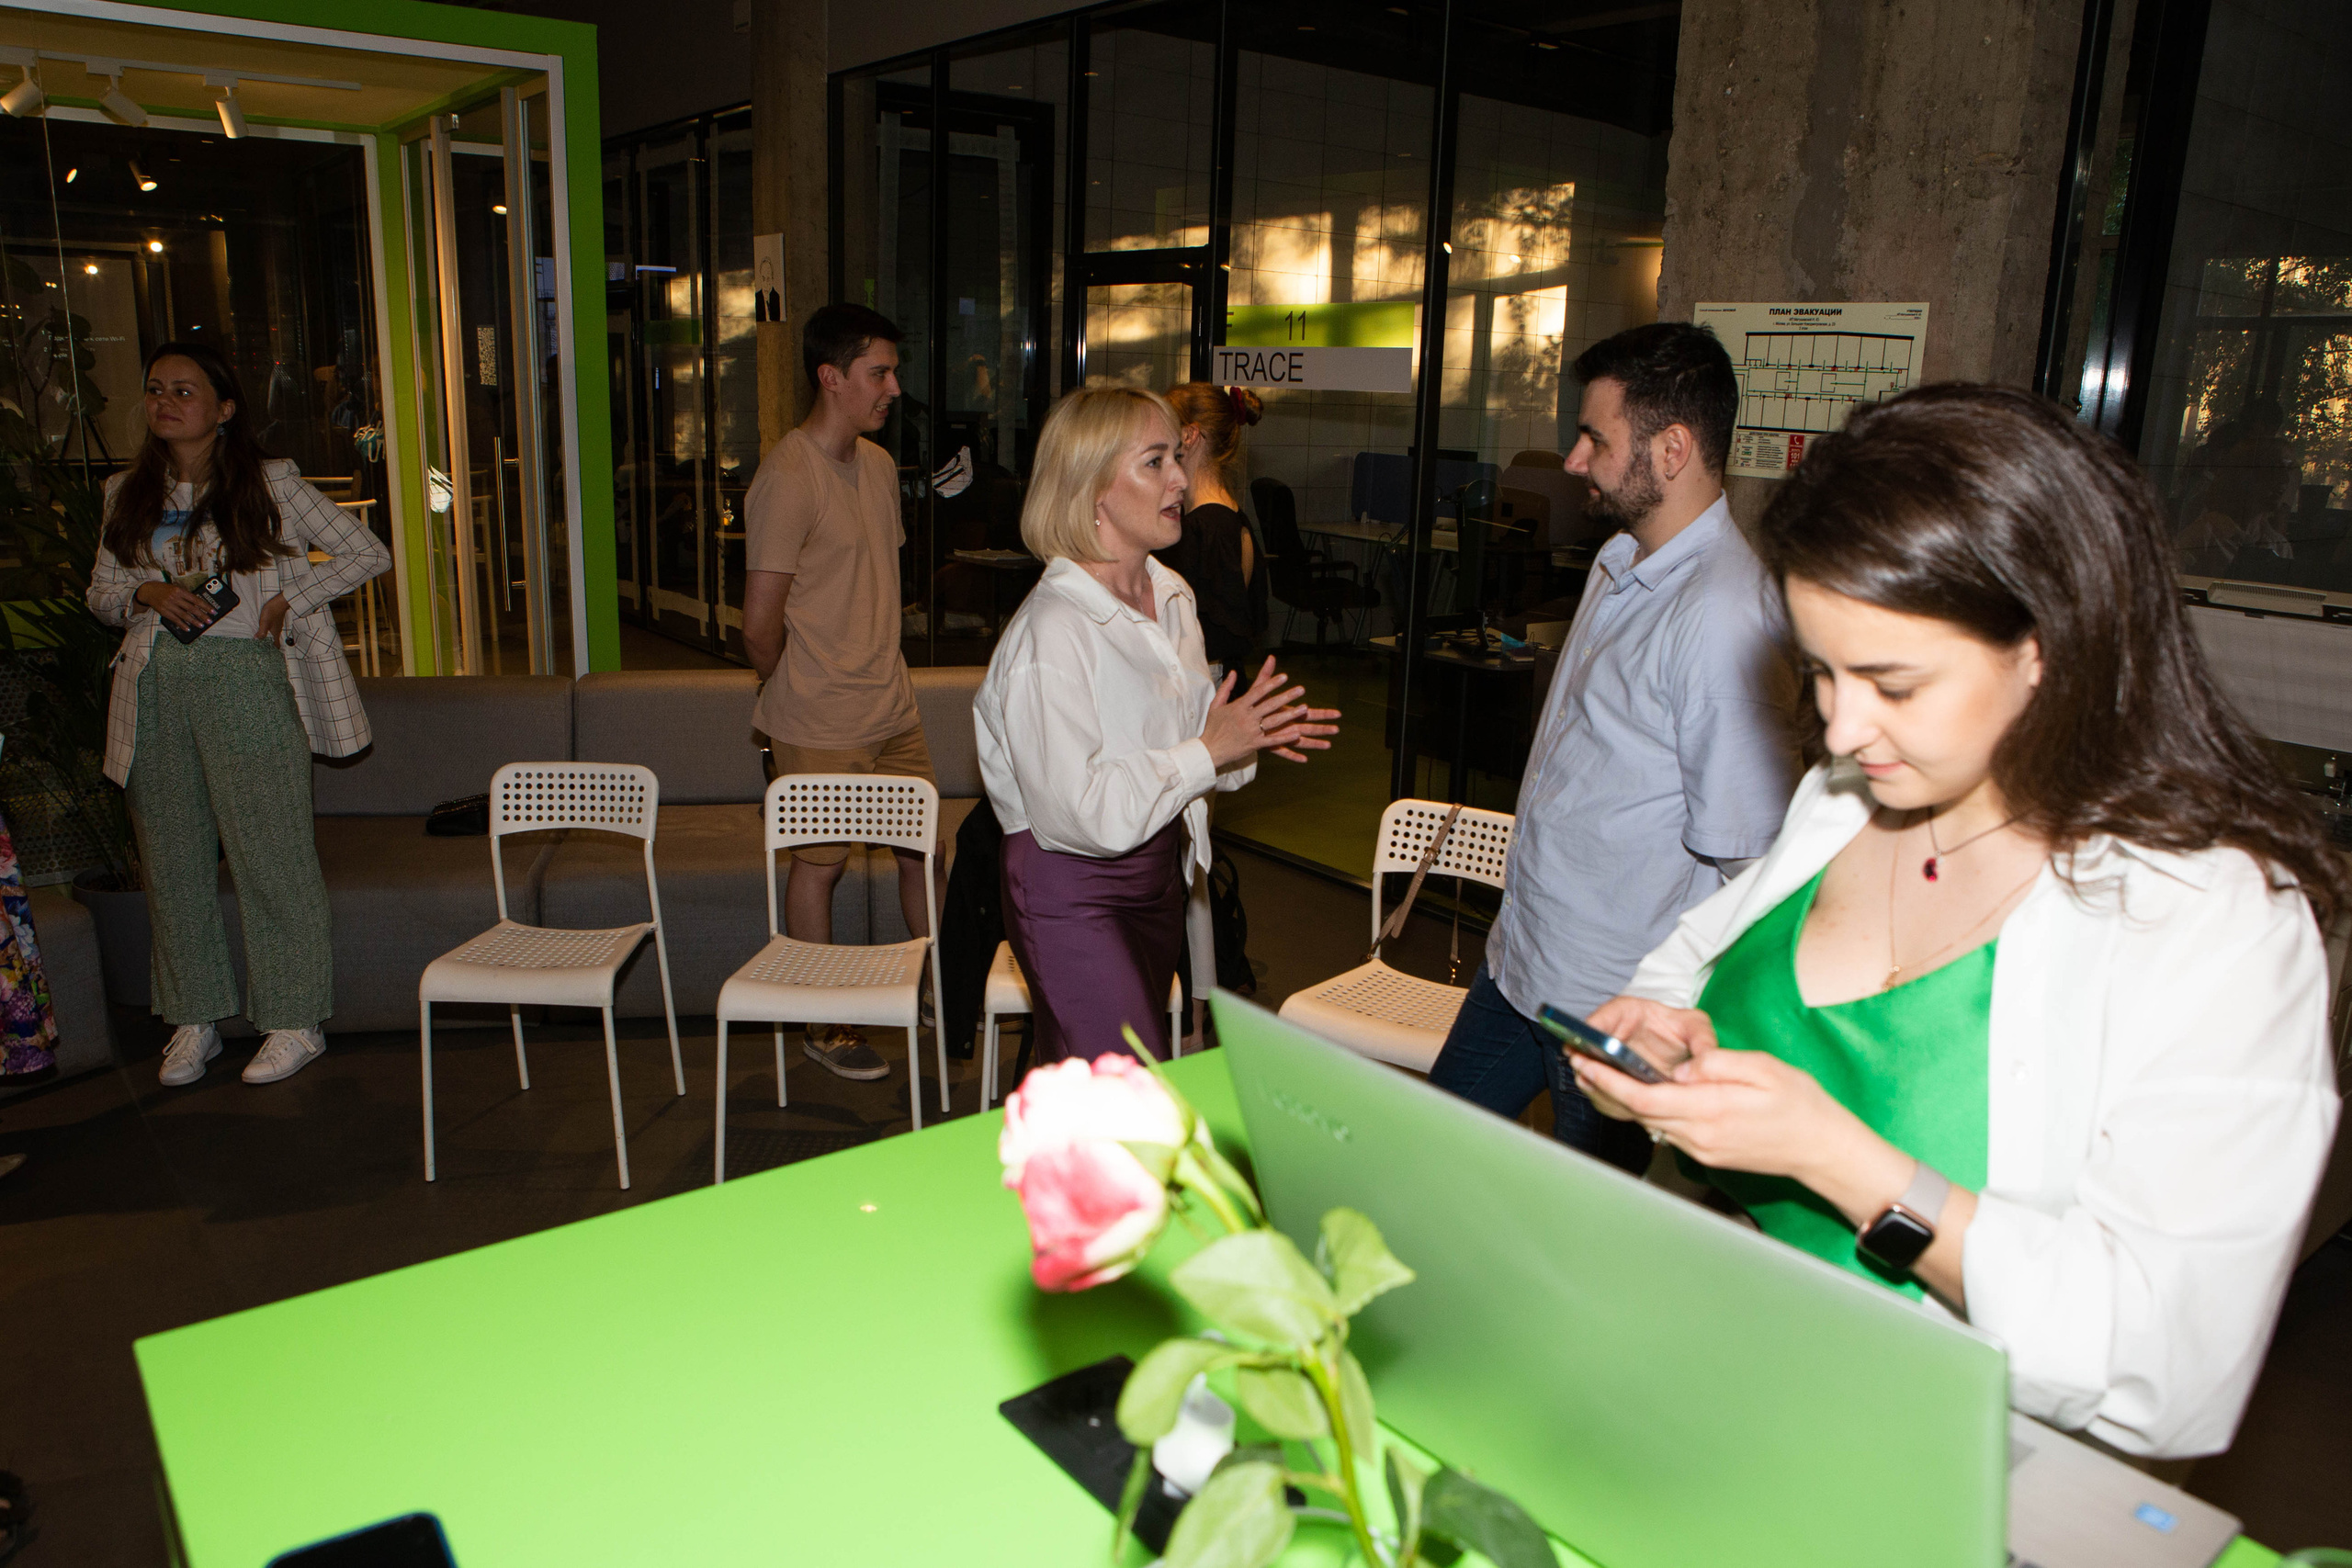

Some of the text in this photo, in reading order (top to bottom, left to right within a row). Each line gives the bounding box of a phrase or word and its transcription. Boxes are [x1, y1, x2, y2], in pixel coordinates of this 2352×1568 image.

[1284, 310, 1306, 341] 11
[1770, 308, 1842, 317] ПЛАН ЭВАКУАЦИИ
[1218, 351, 1304, 383] TRACE
